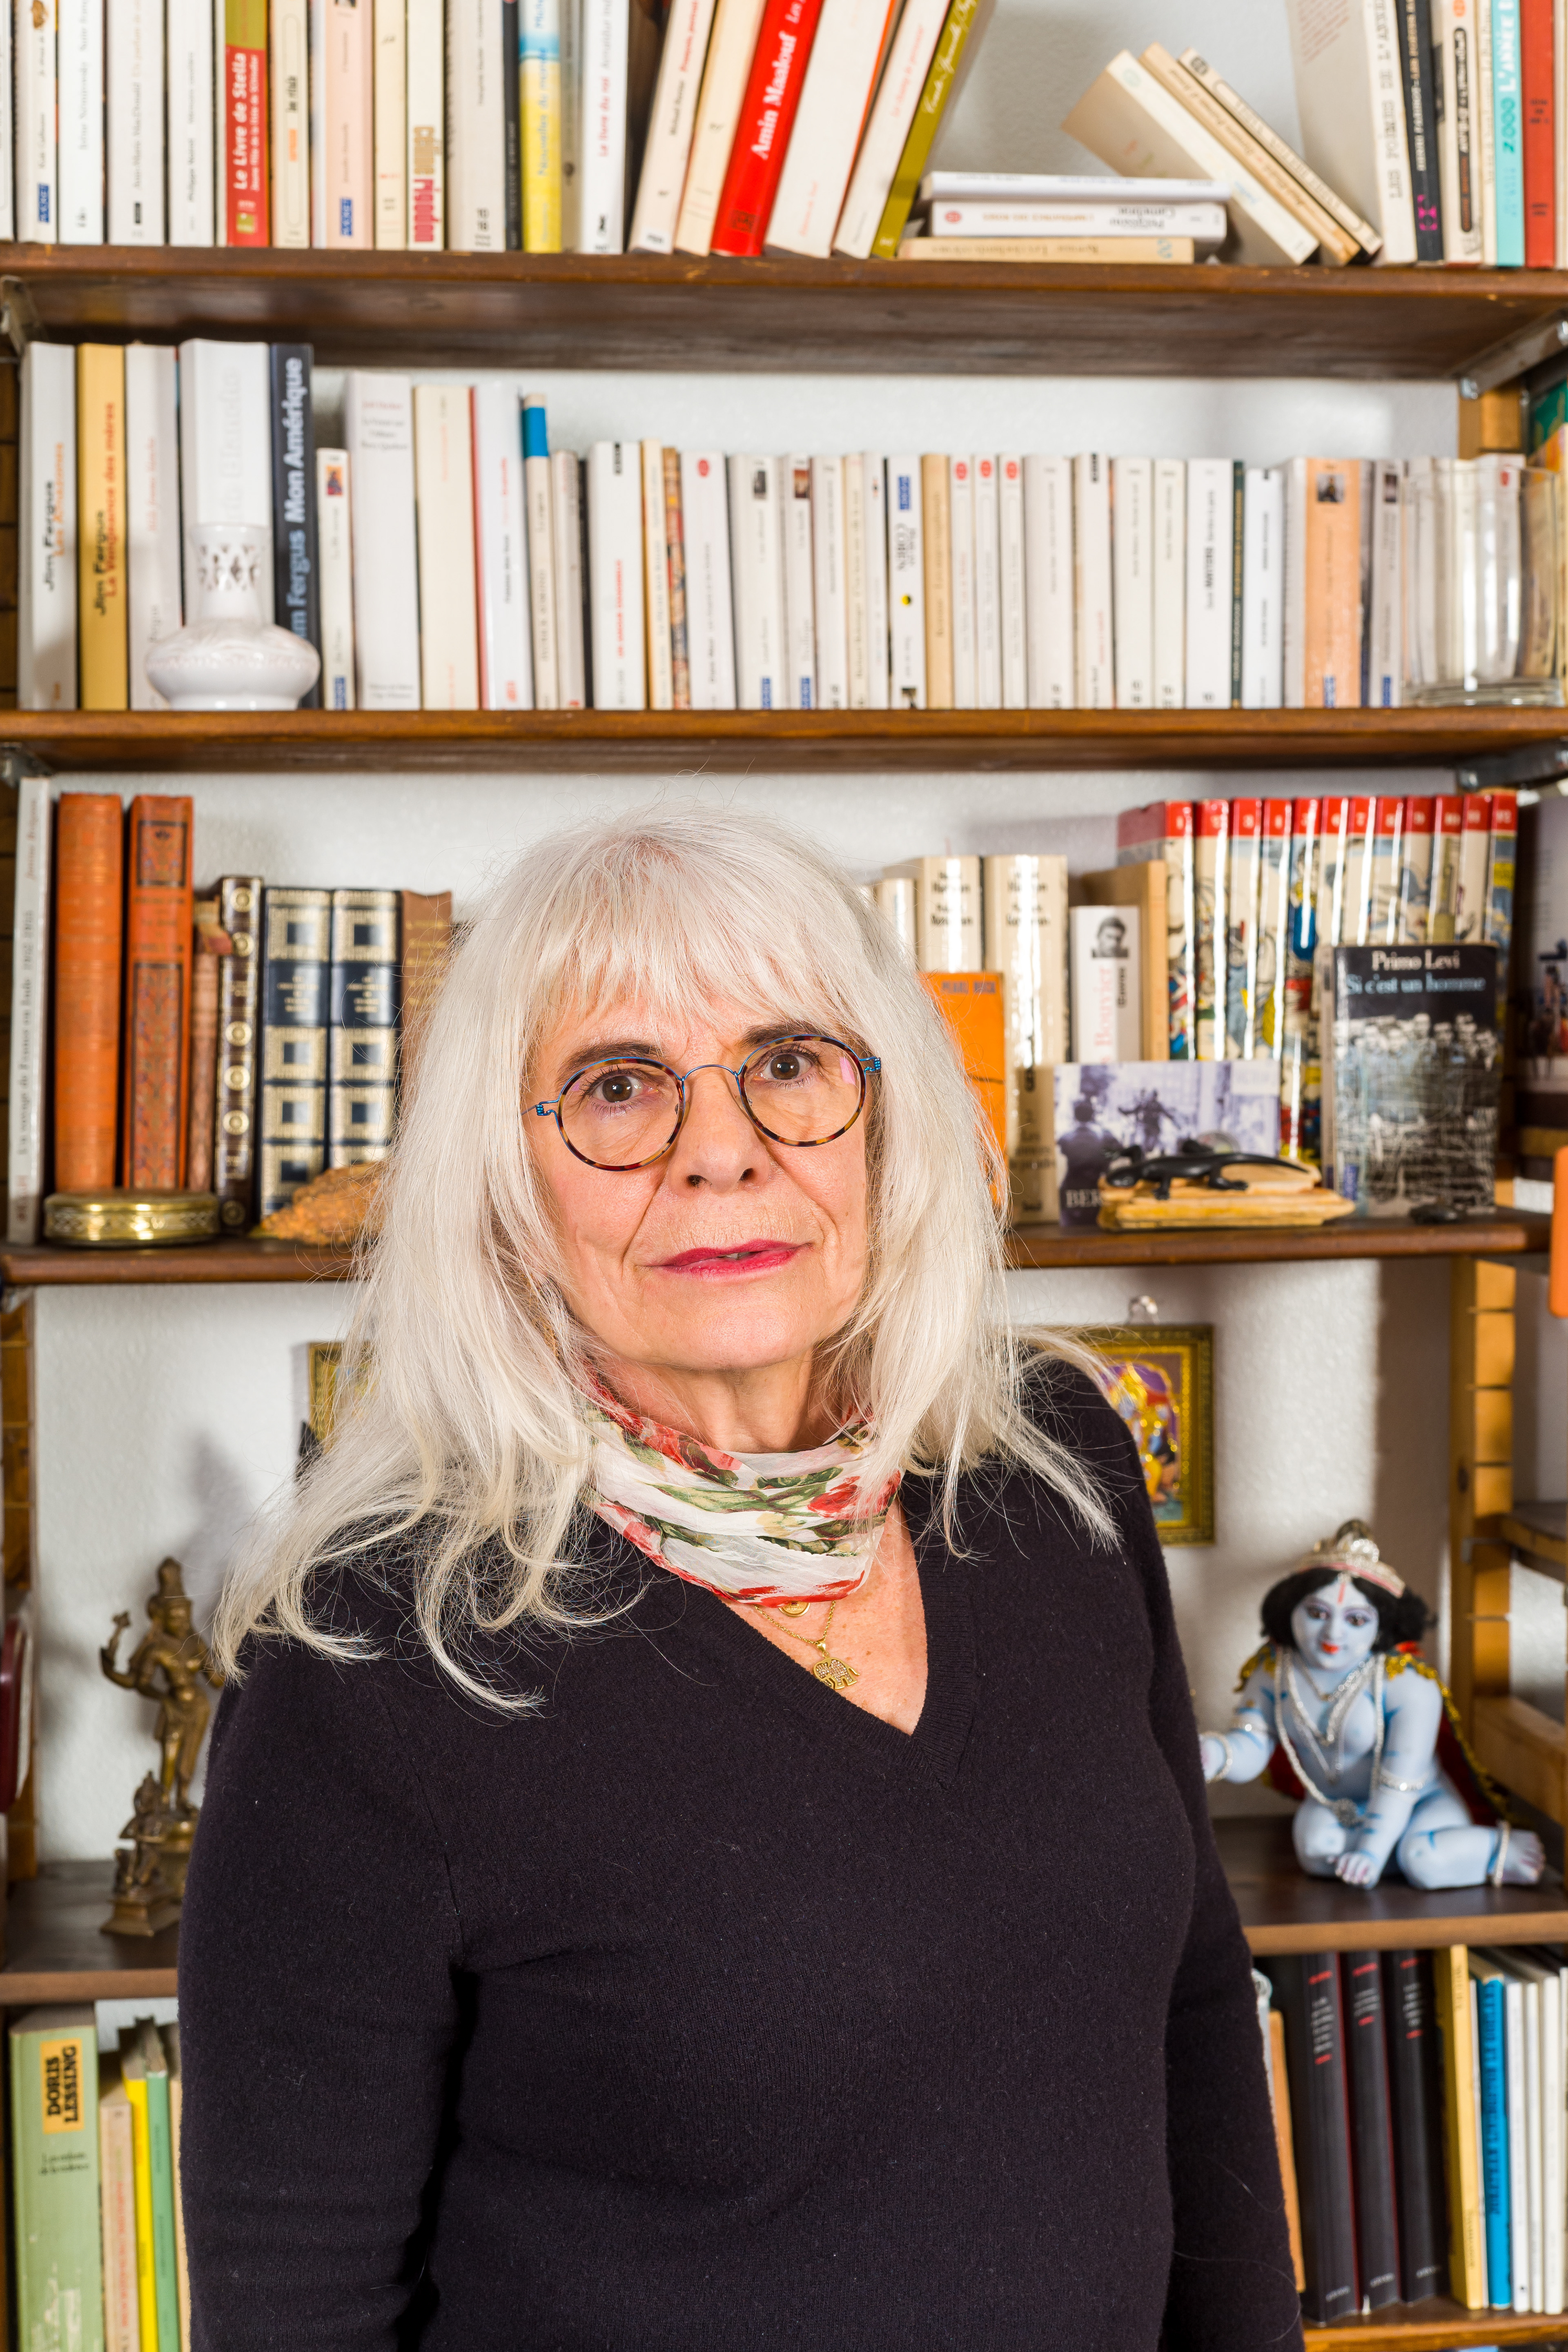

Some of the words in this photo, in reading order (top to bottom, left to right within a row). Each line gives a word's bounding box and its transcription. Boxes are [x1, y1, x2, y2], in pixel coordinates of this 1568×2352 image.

[1368, 0, 1390, 61] L'ANNÉ
[231, 52, 247, 99] Stella
[762, 30, 797, 106] Maalouf
[232, 102, 248, 122] de
[751, 109, 779, 160] Amin
[1500, 97, 1517, 154] 2000
[232, 125, 248, 166] Livre
[233, 169, 248, 189] Le
[283, 357, 309, 468] Amérique
[284, 471, 306, 524] Mon
[287, 529, 310, 607] Fergus
[1346, 973, 1363, 995] Si
[1364, 973, 1399, 994] c'est
[1400, 978, 1423, 993] un
[1425, 972, 1486, 993] homme
[1371, 949, 1422, 972] Primo
[1424, 948, 1461, 971] Levi
[46, 2056, 61, 2116] DORIS
[62, 2045, 78, 2123] LESSING
